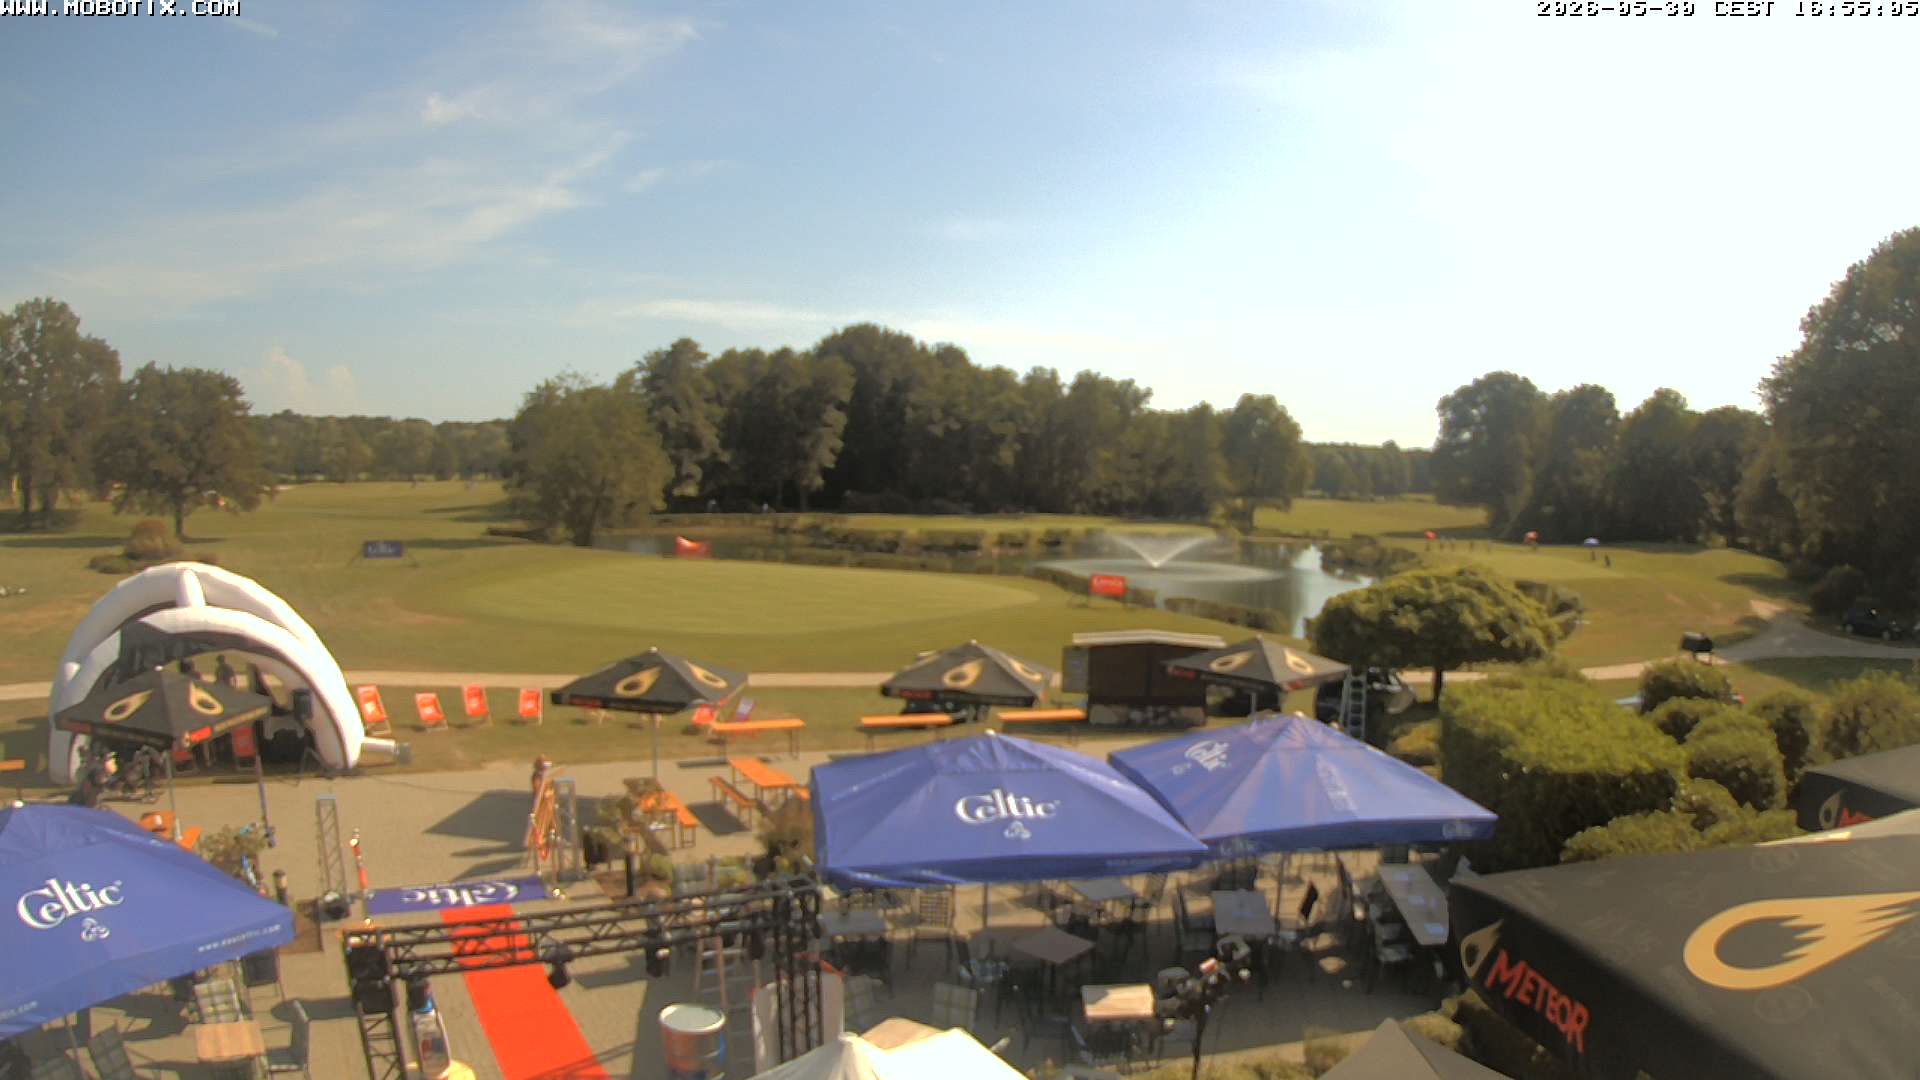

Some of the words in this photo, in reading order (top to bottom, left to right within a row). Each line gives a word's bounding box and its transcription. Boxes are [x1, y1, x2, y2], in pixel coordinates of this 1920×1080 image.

[956, 788, 1057, 823] Celtic
[17, 879, 125, 929] Celtic
[401, 882, 518, 906] Celtic
[1484, 948, 1591, 1056] METEOR
